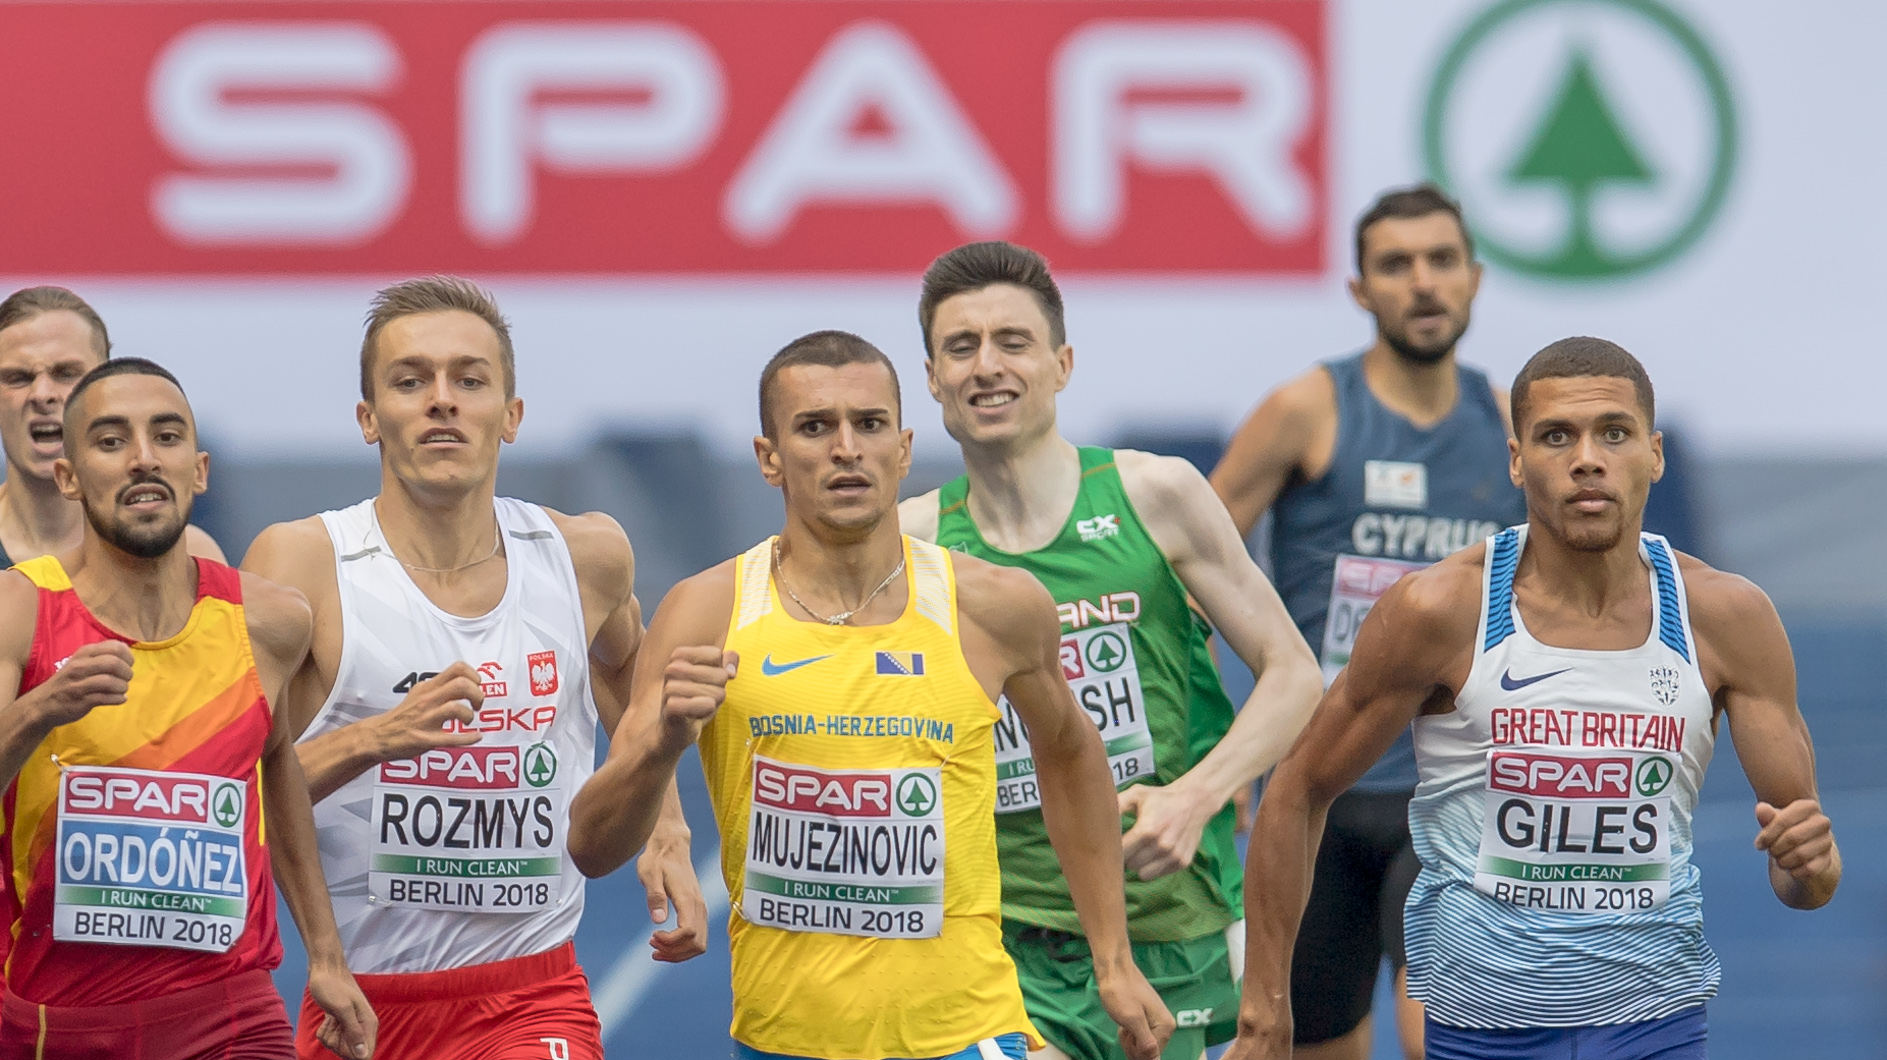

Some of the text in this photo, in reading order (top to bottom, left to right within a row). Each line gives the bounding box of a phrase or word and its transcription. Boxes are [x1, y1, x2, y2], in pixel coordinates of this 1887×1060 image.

[147, 20, 1314, 244] SPAR
[479, 684, 504, 695] LEN
[442, 706, 556, 733] LSKA
[749, 714, 953, 744] BOSNIA-HERZEGOVINA
[1491, 708, 1685, 752] GREAT BRITAIN
[385, 750, 516, 783] SPAR
[997, 757, 1139, 807] BER 18
[1017, 760, 1035, 774] RU
[1495, 757, 1627, 793] SPAR
[69, 777, 206, 816] SPAR
[757, 768, 887, 811] SPAR
[380, 793, 553, 849] ROZMYS
[1496, 798, 1657, 854] GILES
[64, 827, 241, 893] ORDÓÑEZ
[752, 811, 937, 876] MUJEZINOVIC
[416, 859, 420, 872] I
[426, 859, 462, 874] RUN
[1522, 864, 1526, 877] I
[1531, 865, 1565, 880] RUN
[101, 890, 105, 904] I
[111, 890, 146, 908] RUN
[390, 879, 548, 906] BERLIN 2018
[784, 881, 788, 894] I
[794, 882, 830, 898] RUN
[1494, 882, 1654, 909] BERLIN 2018
[74, 911, 232, 946] BERLIN 2018
[760, 898, 924, 933] BERLIN 2018
